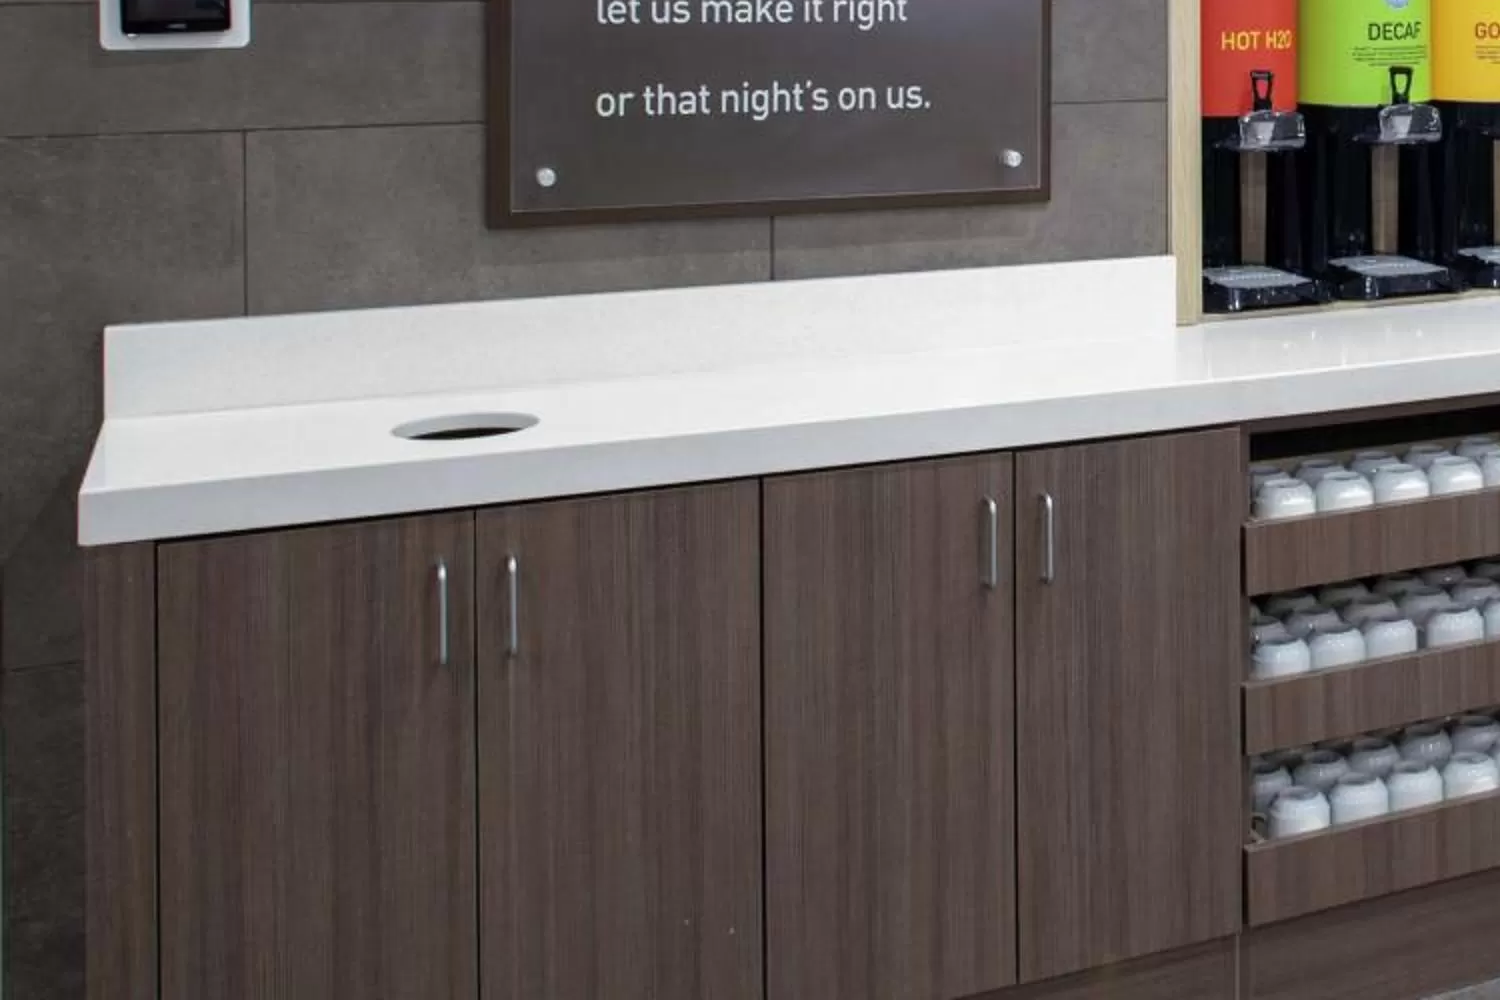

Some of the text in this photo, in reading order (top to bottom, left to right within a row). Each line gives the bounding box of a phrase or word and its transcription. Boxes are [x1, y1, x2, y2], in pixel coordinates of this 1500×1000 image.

[650, 0, 691, 25] us
[1221, 31, 1261, 51] HOT
[1367, 21, 1422, 41] DECAF
[596, 79, 932, 121] or that night's on us.
